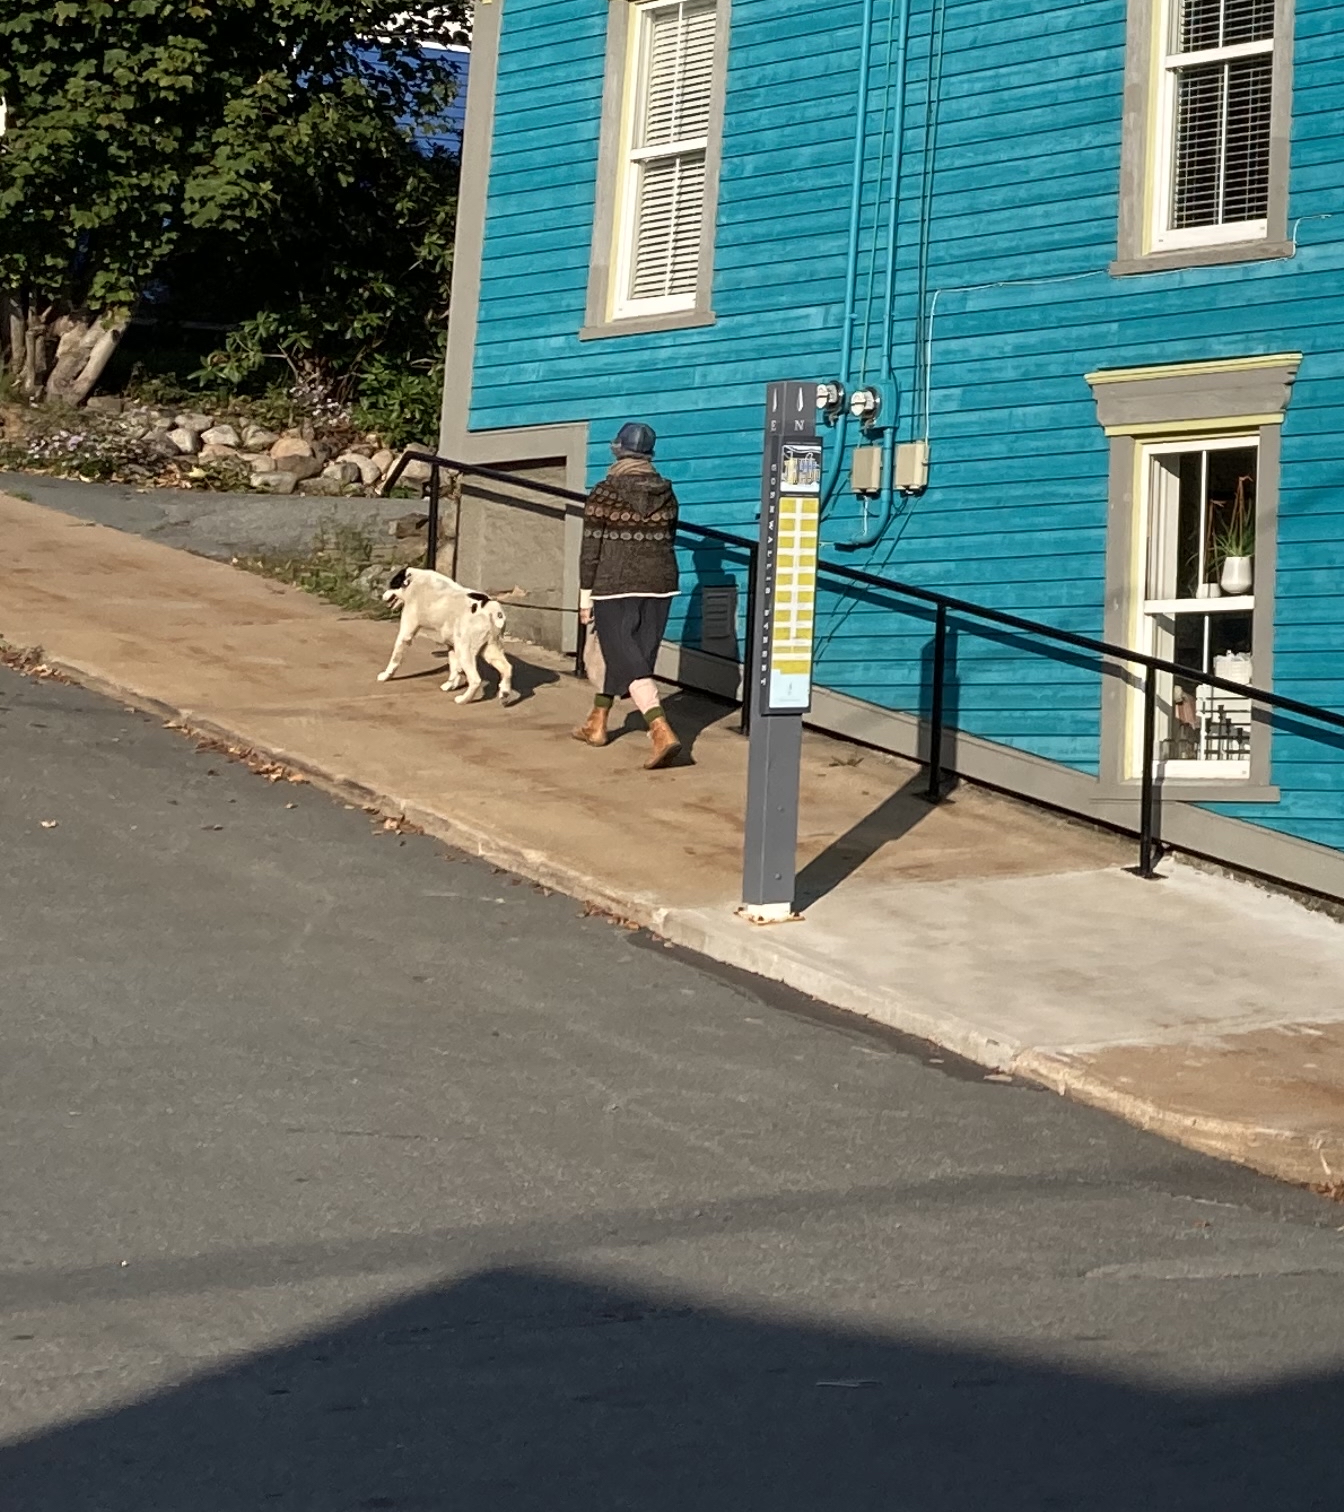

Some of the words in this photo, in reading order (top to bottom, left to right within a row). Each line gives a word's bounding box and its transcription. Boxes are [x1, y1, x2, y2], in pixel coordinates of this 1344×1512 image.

[770, 420, 777, 432] E
[794, 420, 805, 431] N
[765, 464, 777, 594] CORNWALLIS
